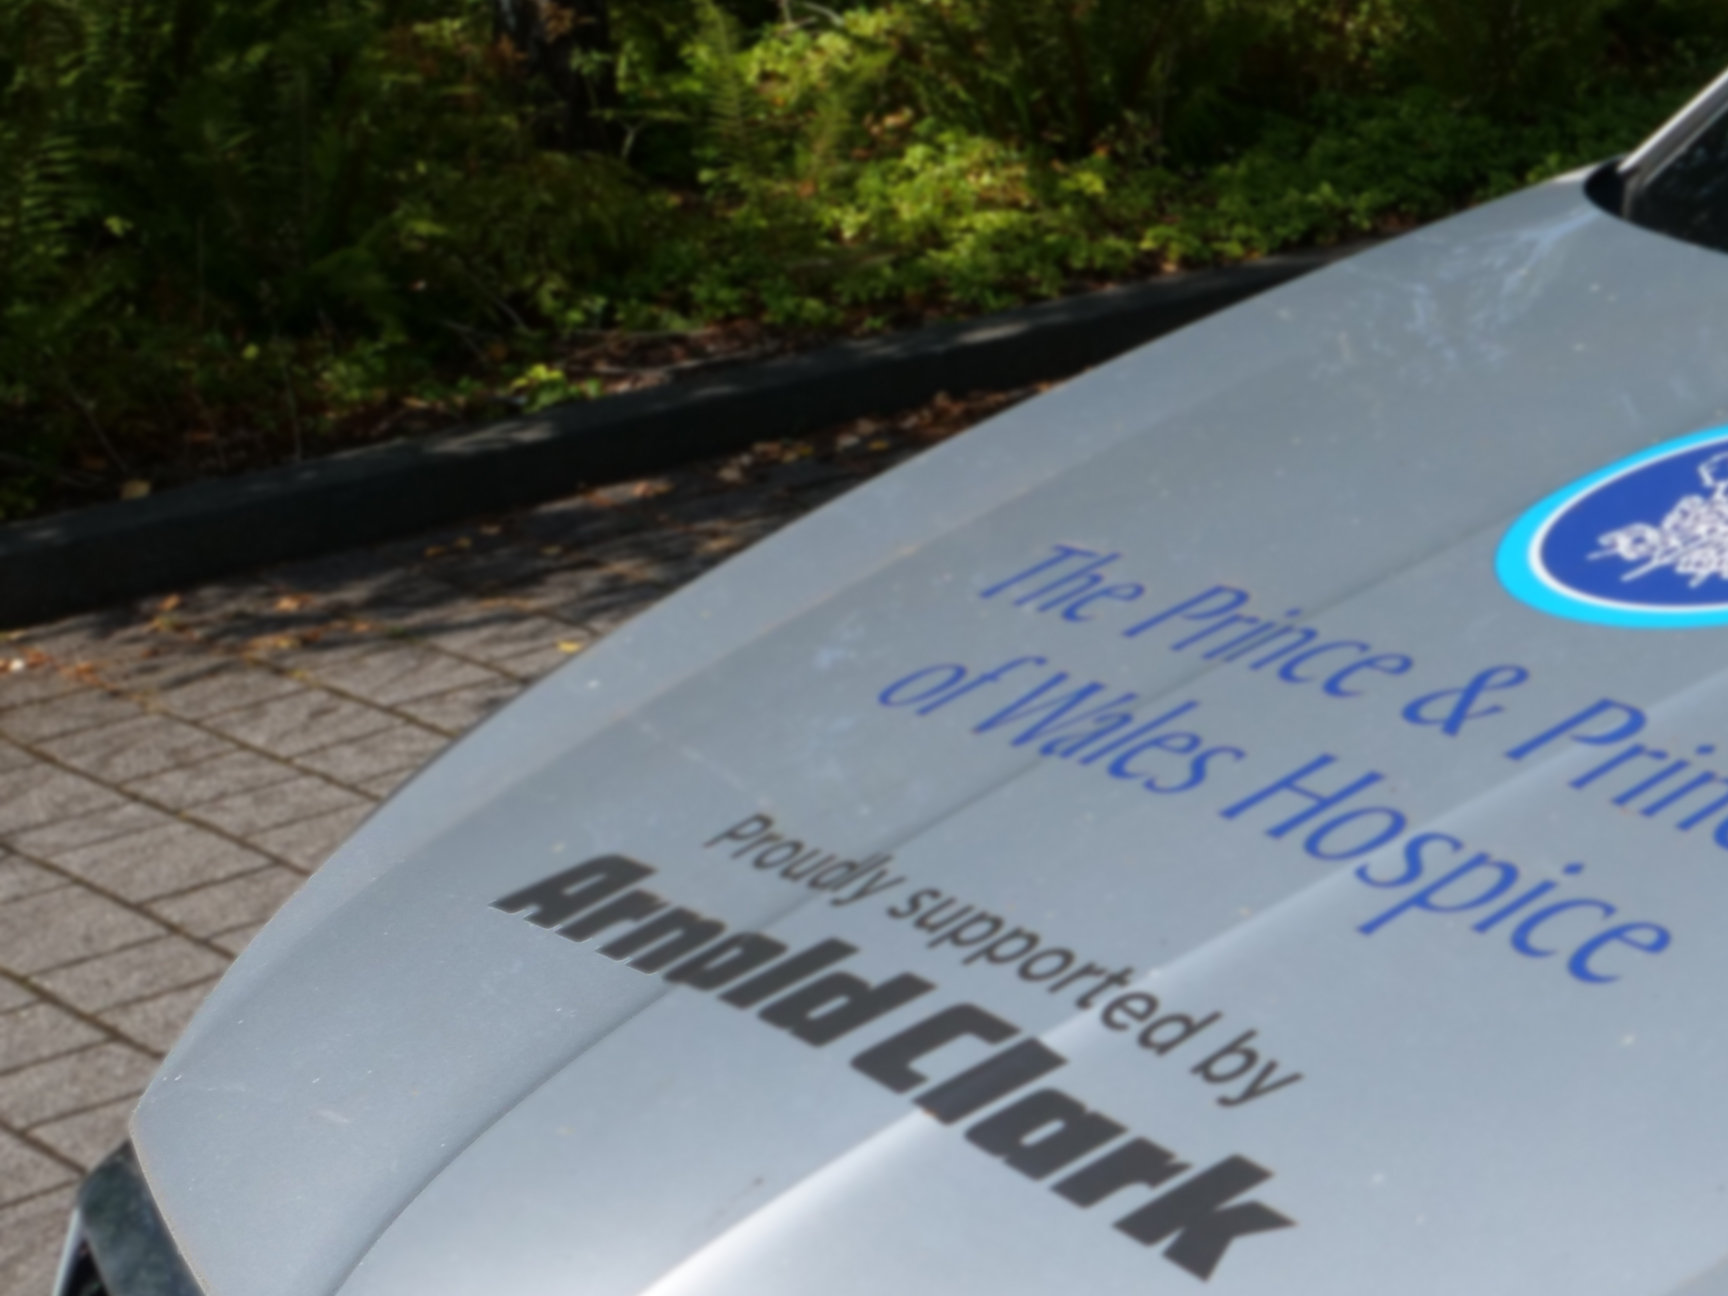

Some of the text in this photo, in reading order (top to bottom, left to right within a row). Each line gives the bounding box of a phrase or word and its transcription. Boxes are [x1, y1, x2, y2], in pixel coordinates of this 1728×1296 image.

[977, 544, 1147, 622] The
[1121, 585, 1414, 699] Prince
[1400, 663, 1531, 737] &
[703, 813, 1305, 1108] Proudly supported by
[877, 655, 1672, 984] of Wales Hospice
[490, 853, 1299, 1283] Arnold Clark
